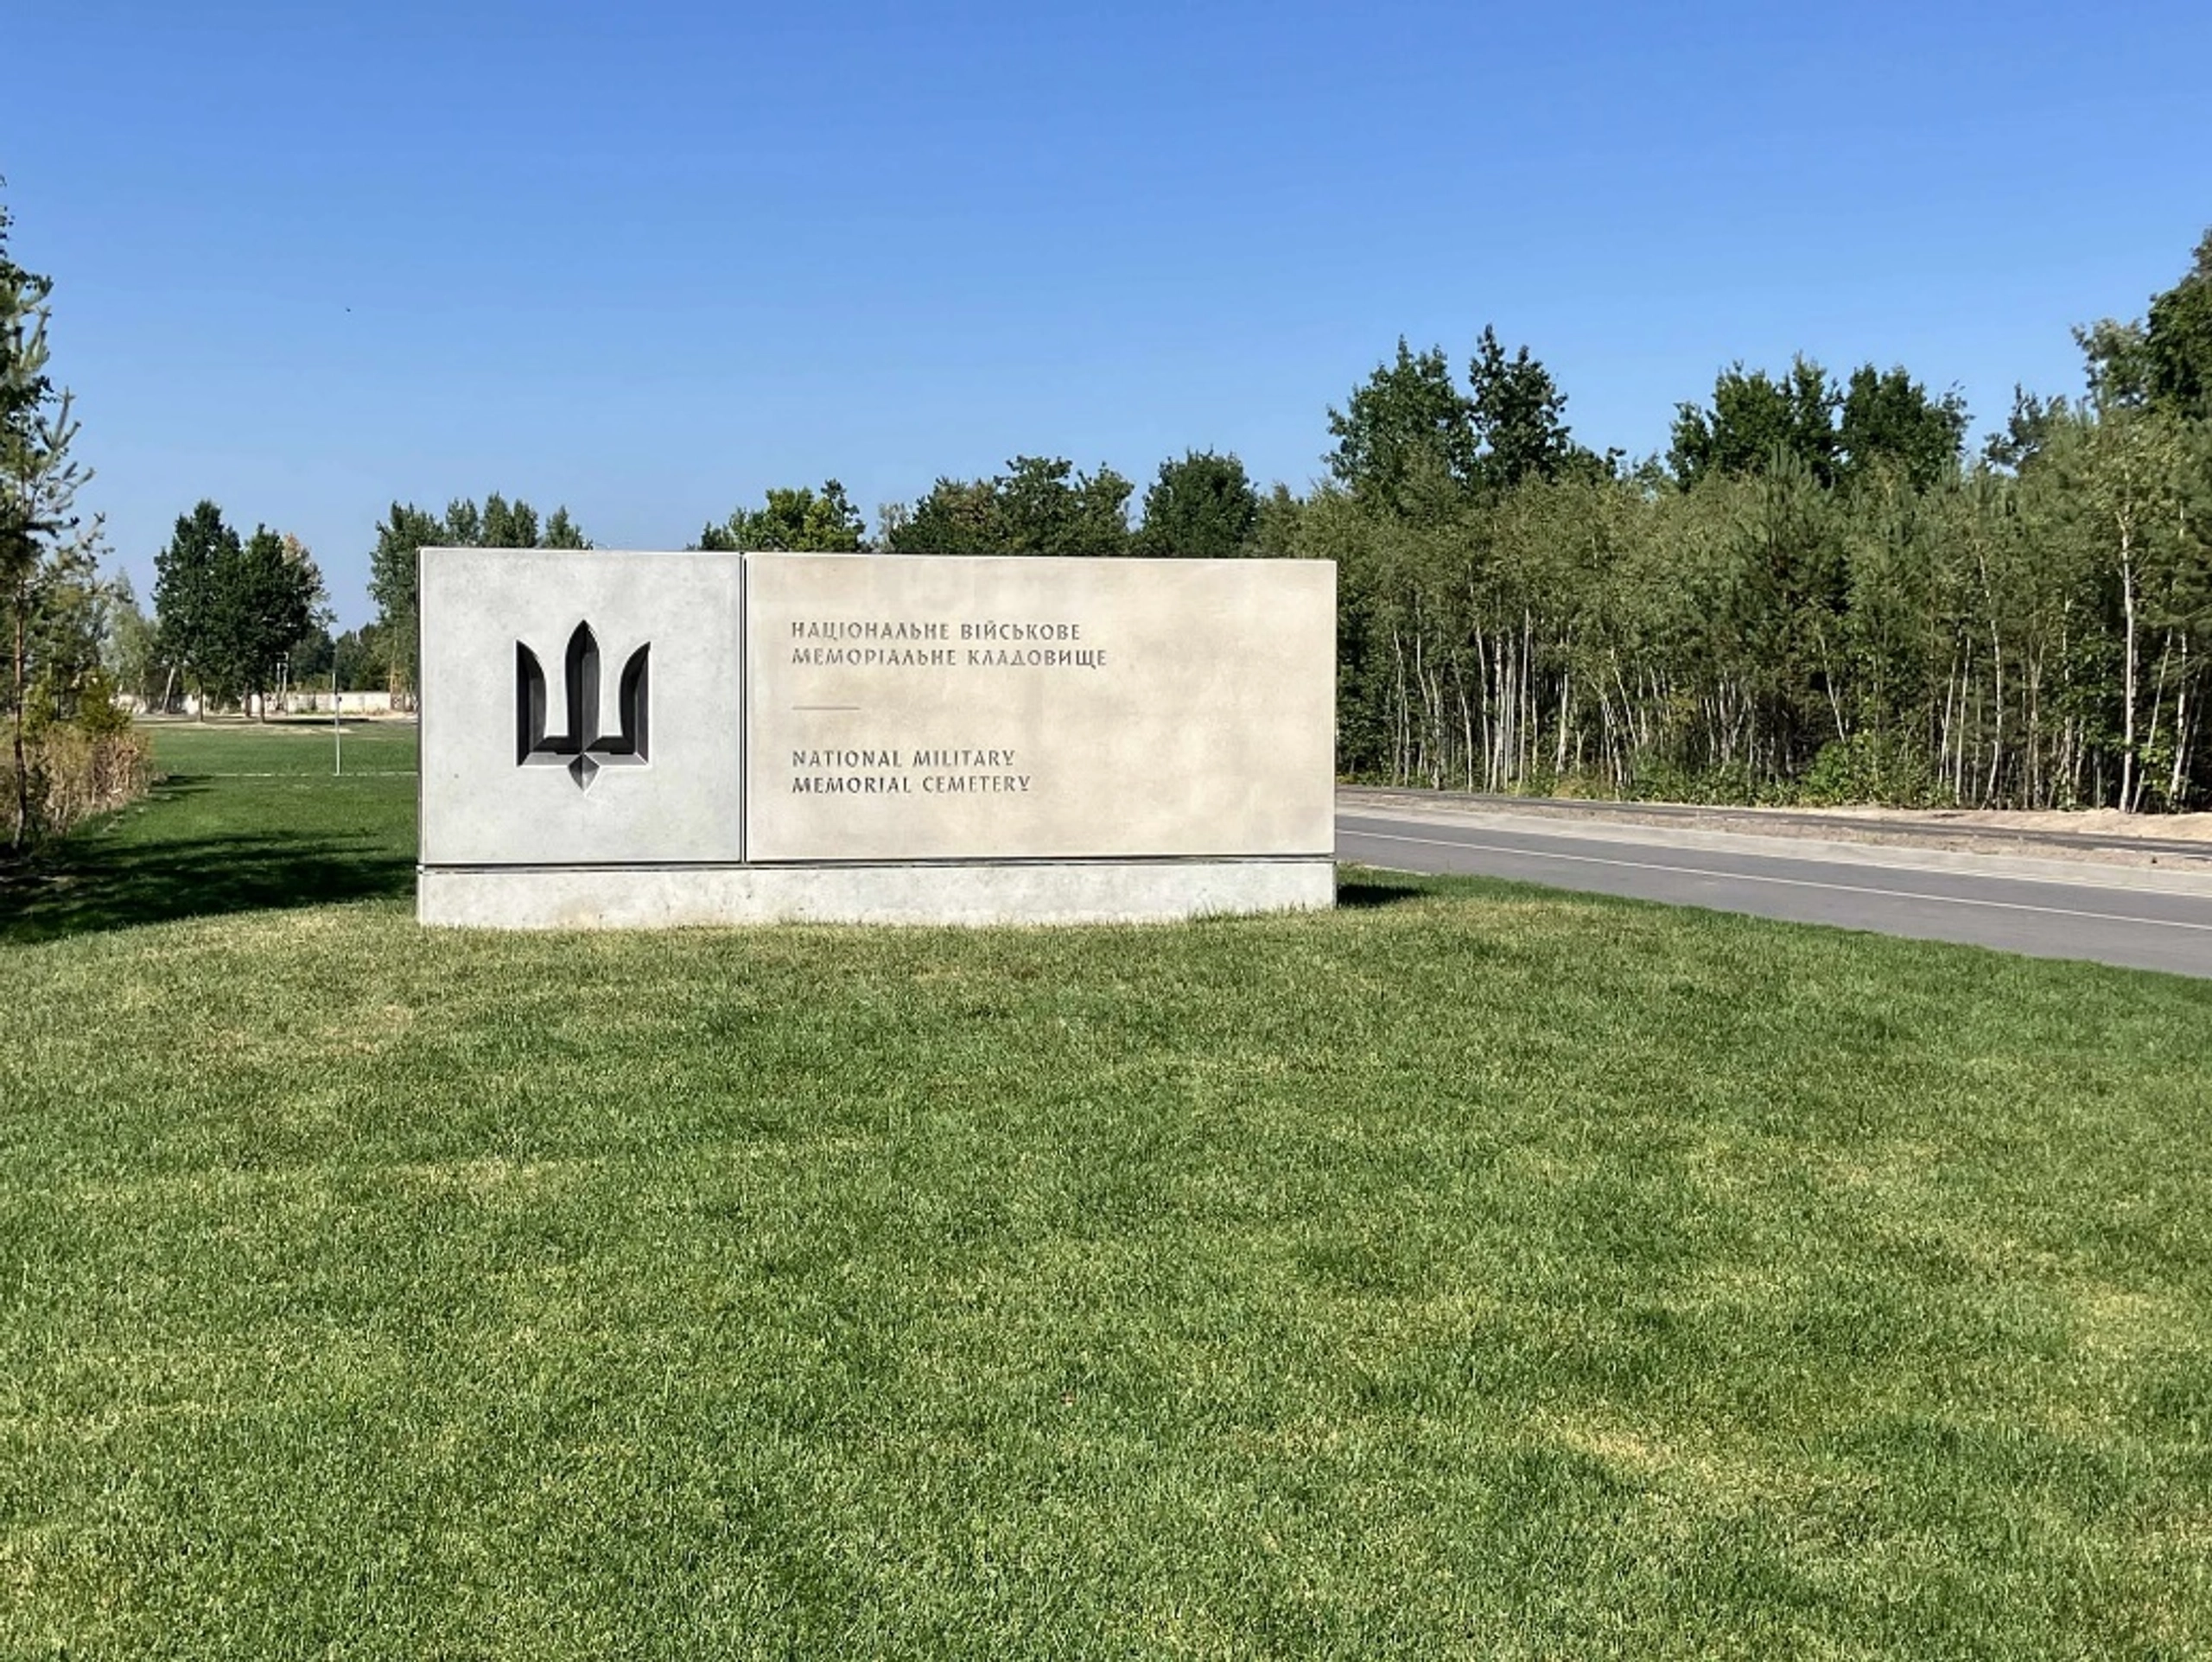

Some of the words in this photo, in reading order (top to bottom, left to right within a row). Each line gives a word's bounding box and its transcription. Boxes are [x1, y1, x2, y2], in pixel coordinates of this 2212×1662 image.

[791, 621, 950, 642] НАЦІОНАЛЬНЕ
[961, 619, 1081, 641] ВІЙСЬКОВЕ
[791, 648, 957, 666] МЕМОРІАЛЬНЕ
[967, 649, 1108, 669] КЛАДОВИЩЕ
[791, 750, 903, 768] NATIONAL
[912, 750, 1016, 767] MILITARY
[791, 776, 912, 794] MEMORIAL
[922, 775, 1032, 793] CEMETERY
